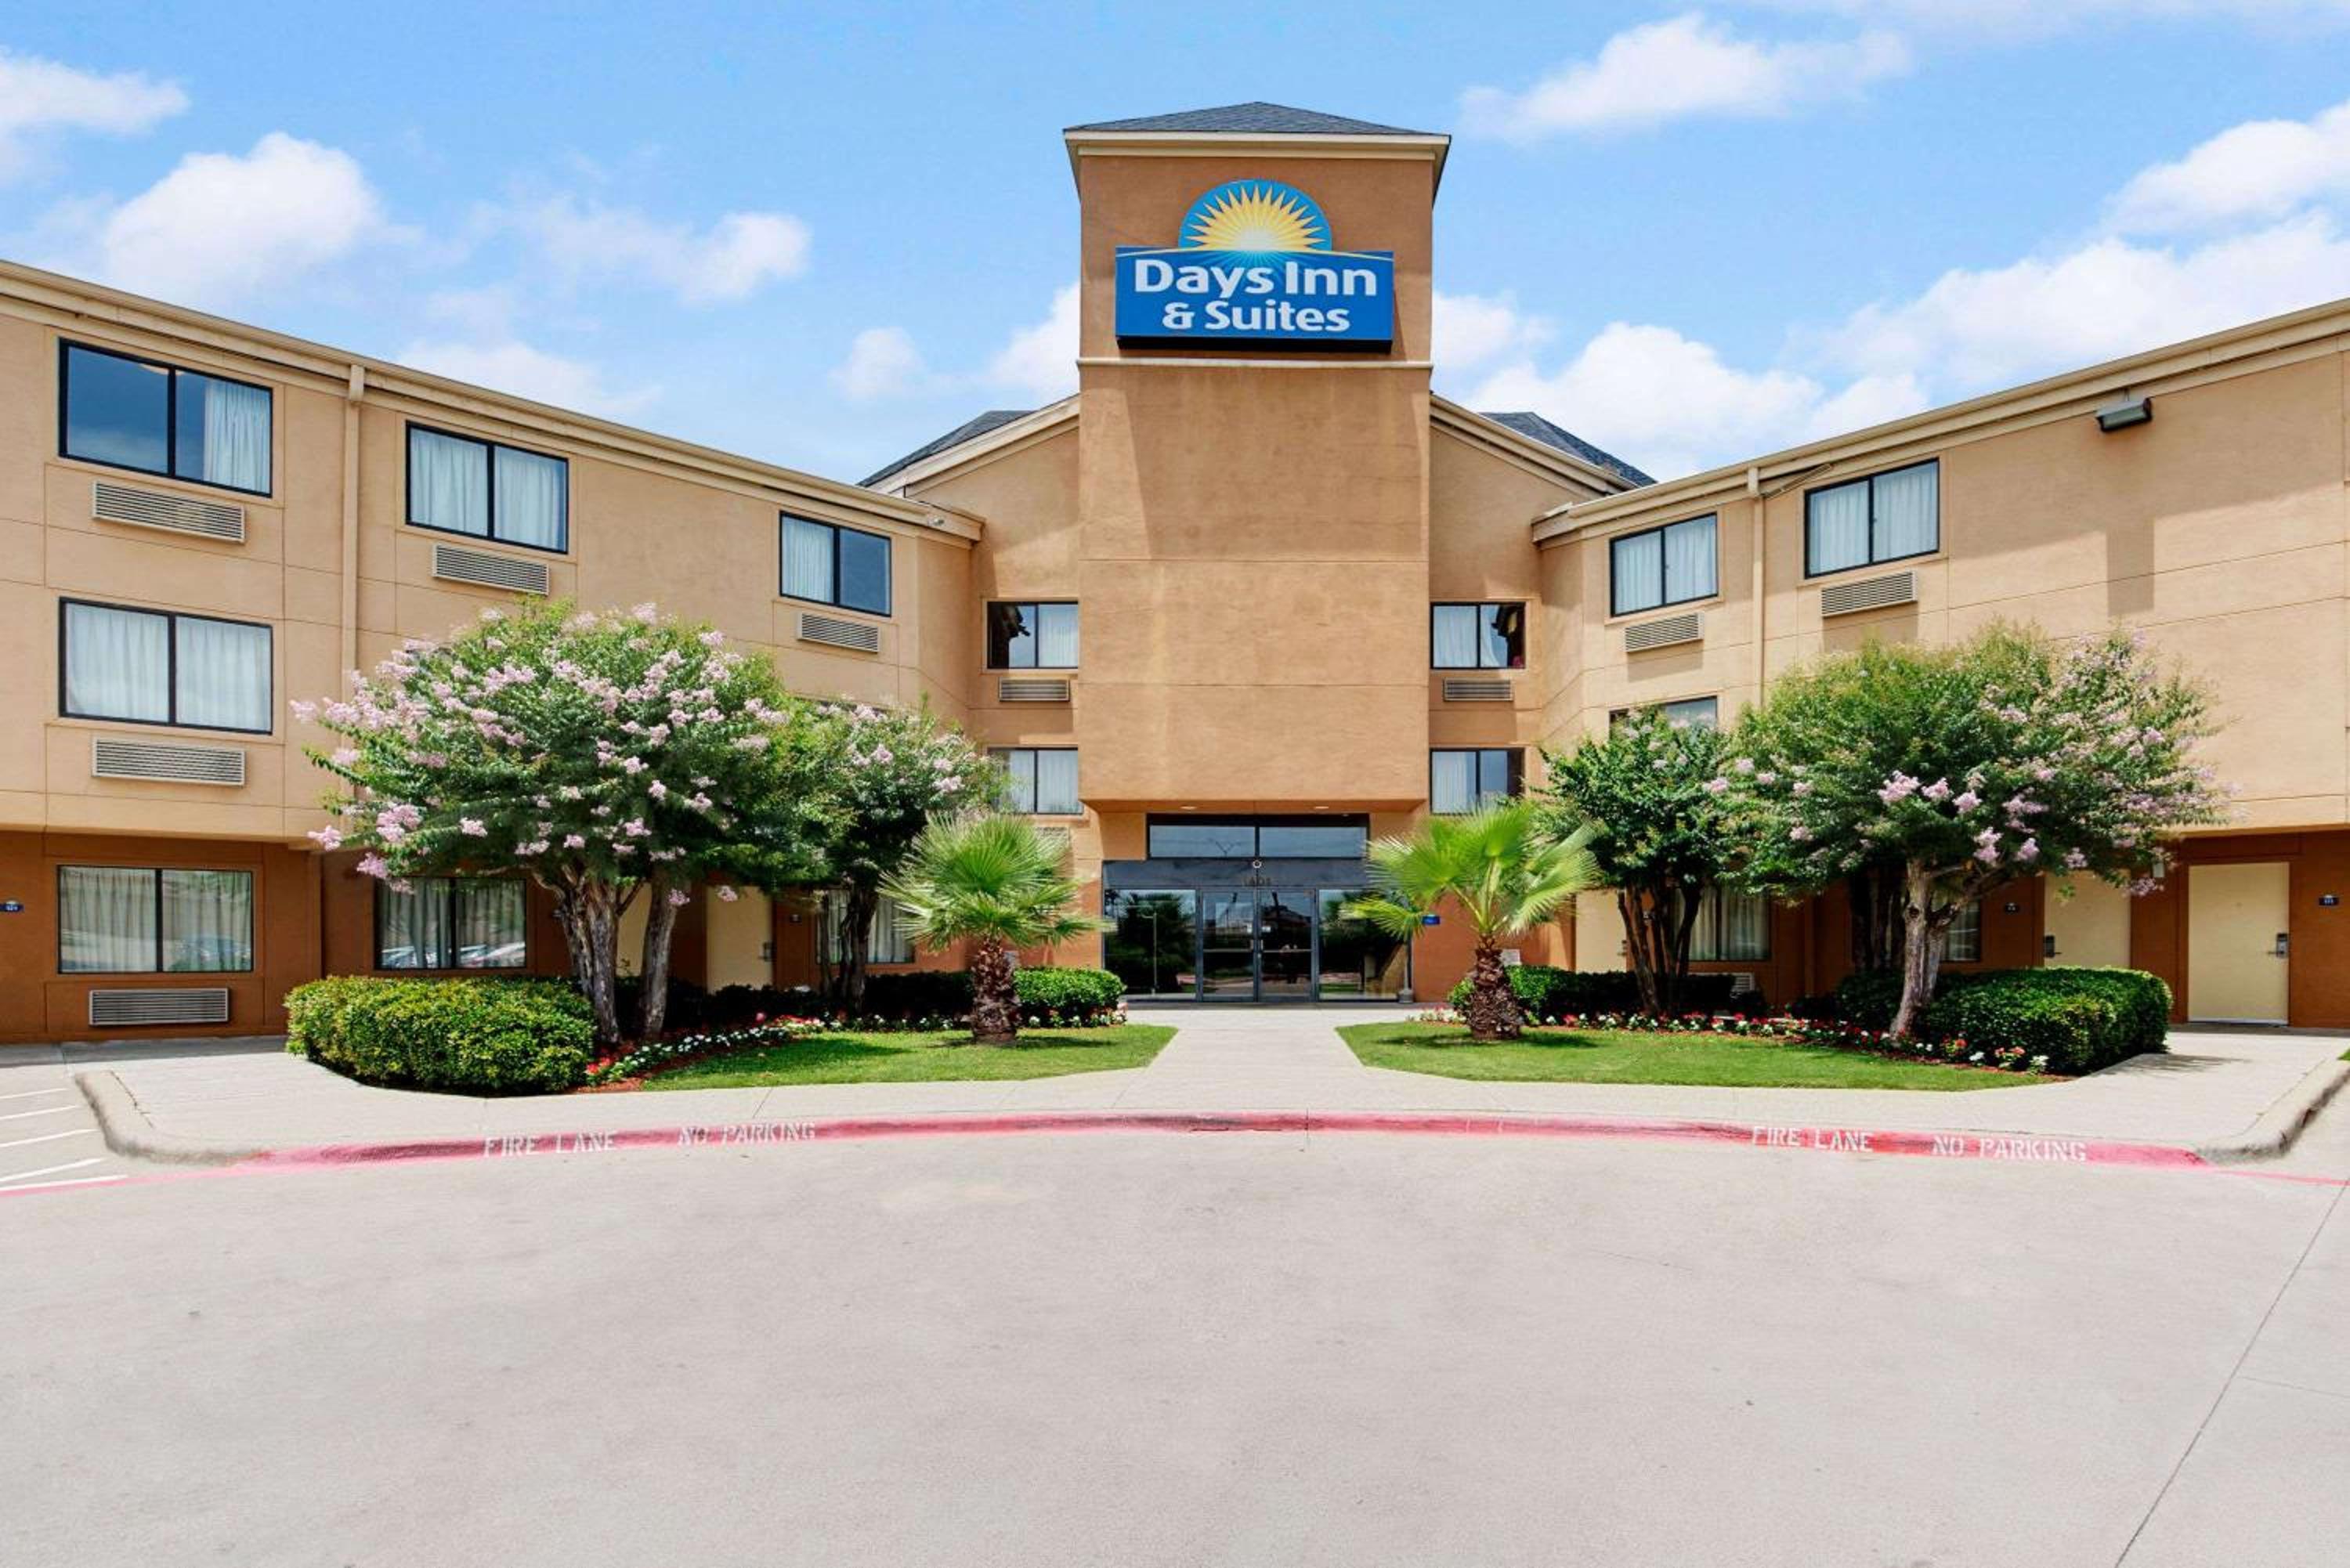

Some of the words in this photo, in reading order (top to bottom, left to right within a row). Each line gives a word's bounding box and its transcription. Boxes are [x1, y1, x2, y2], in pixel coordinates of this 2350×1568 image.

[1135, 259, 1274, 298] Days
[1285, 262, 1377, 296] Inn
[1162, 302, 1194, 330] &
[1204, 299, 1350, 332] Suites
[483, 1135, 539, 1158] FIRE
[556, 1132, 616, 1154] LANE
[677, 1126, 707, 1146] NO
[721, 1122, 815, 1145] PARKING
[1752, 1126, 1801, 1147] FIRE
[1815, 1129, 1873, 1153] LANE
[1932, 1136, 1964, 1155] NO
[1979, 1138, 2087, 1162] PARKING
